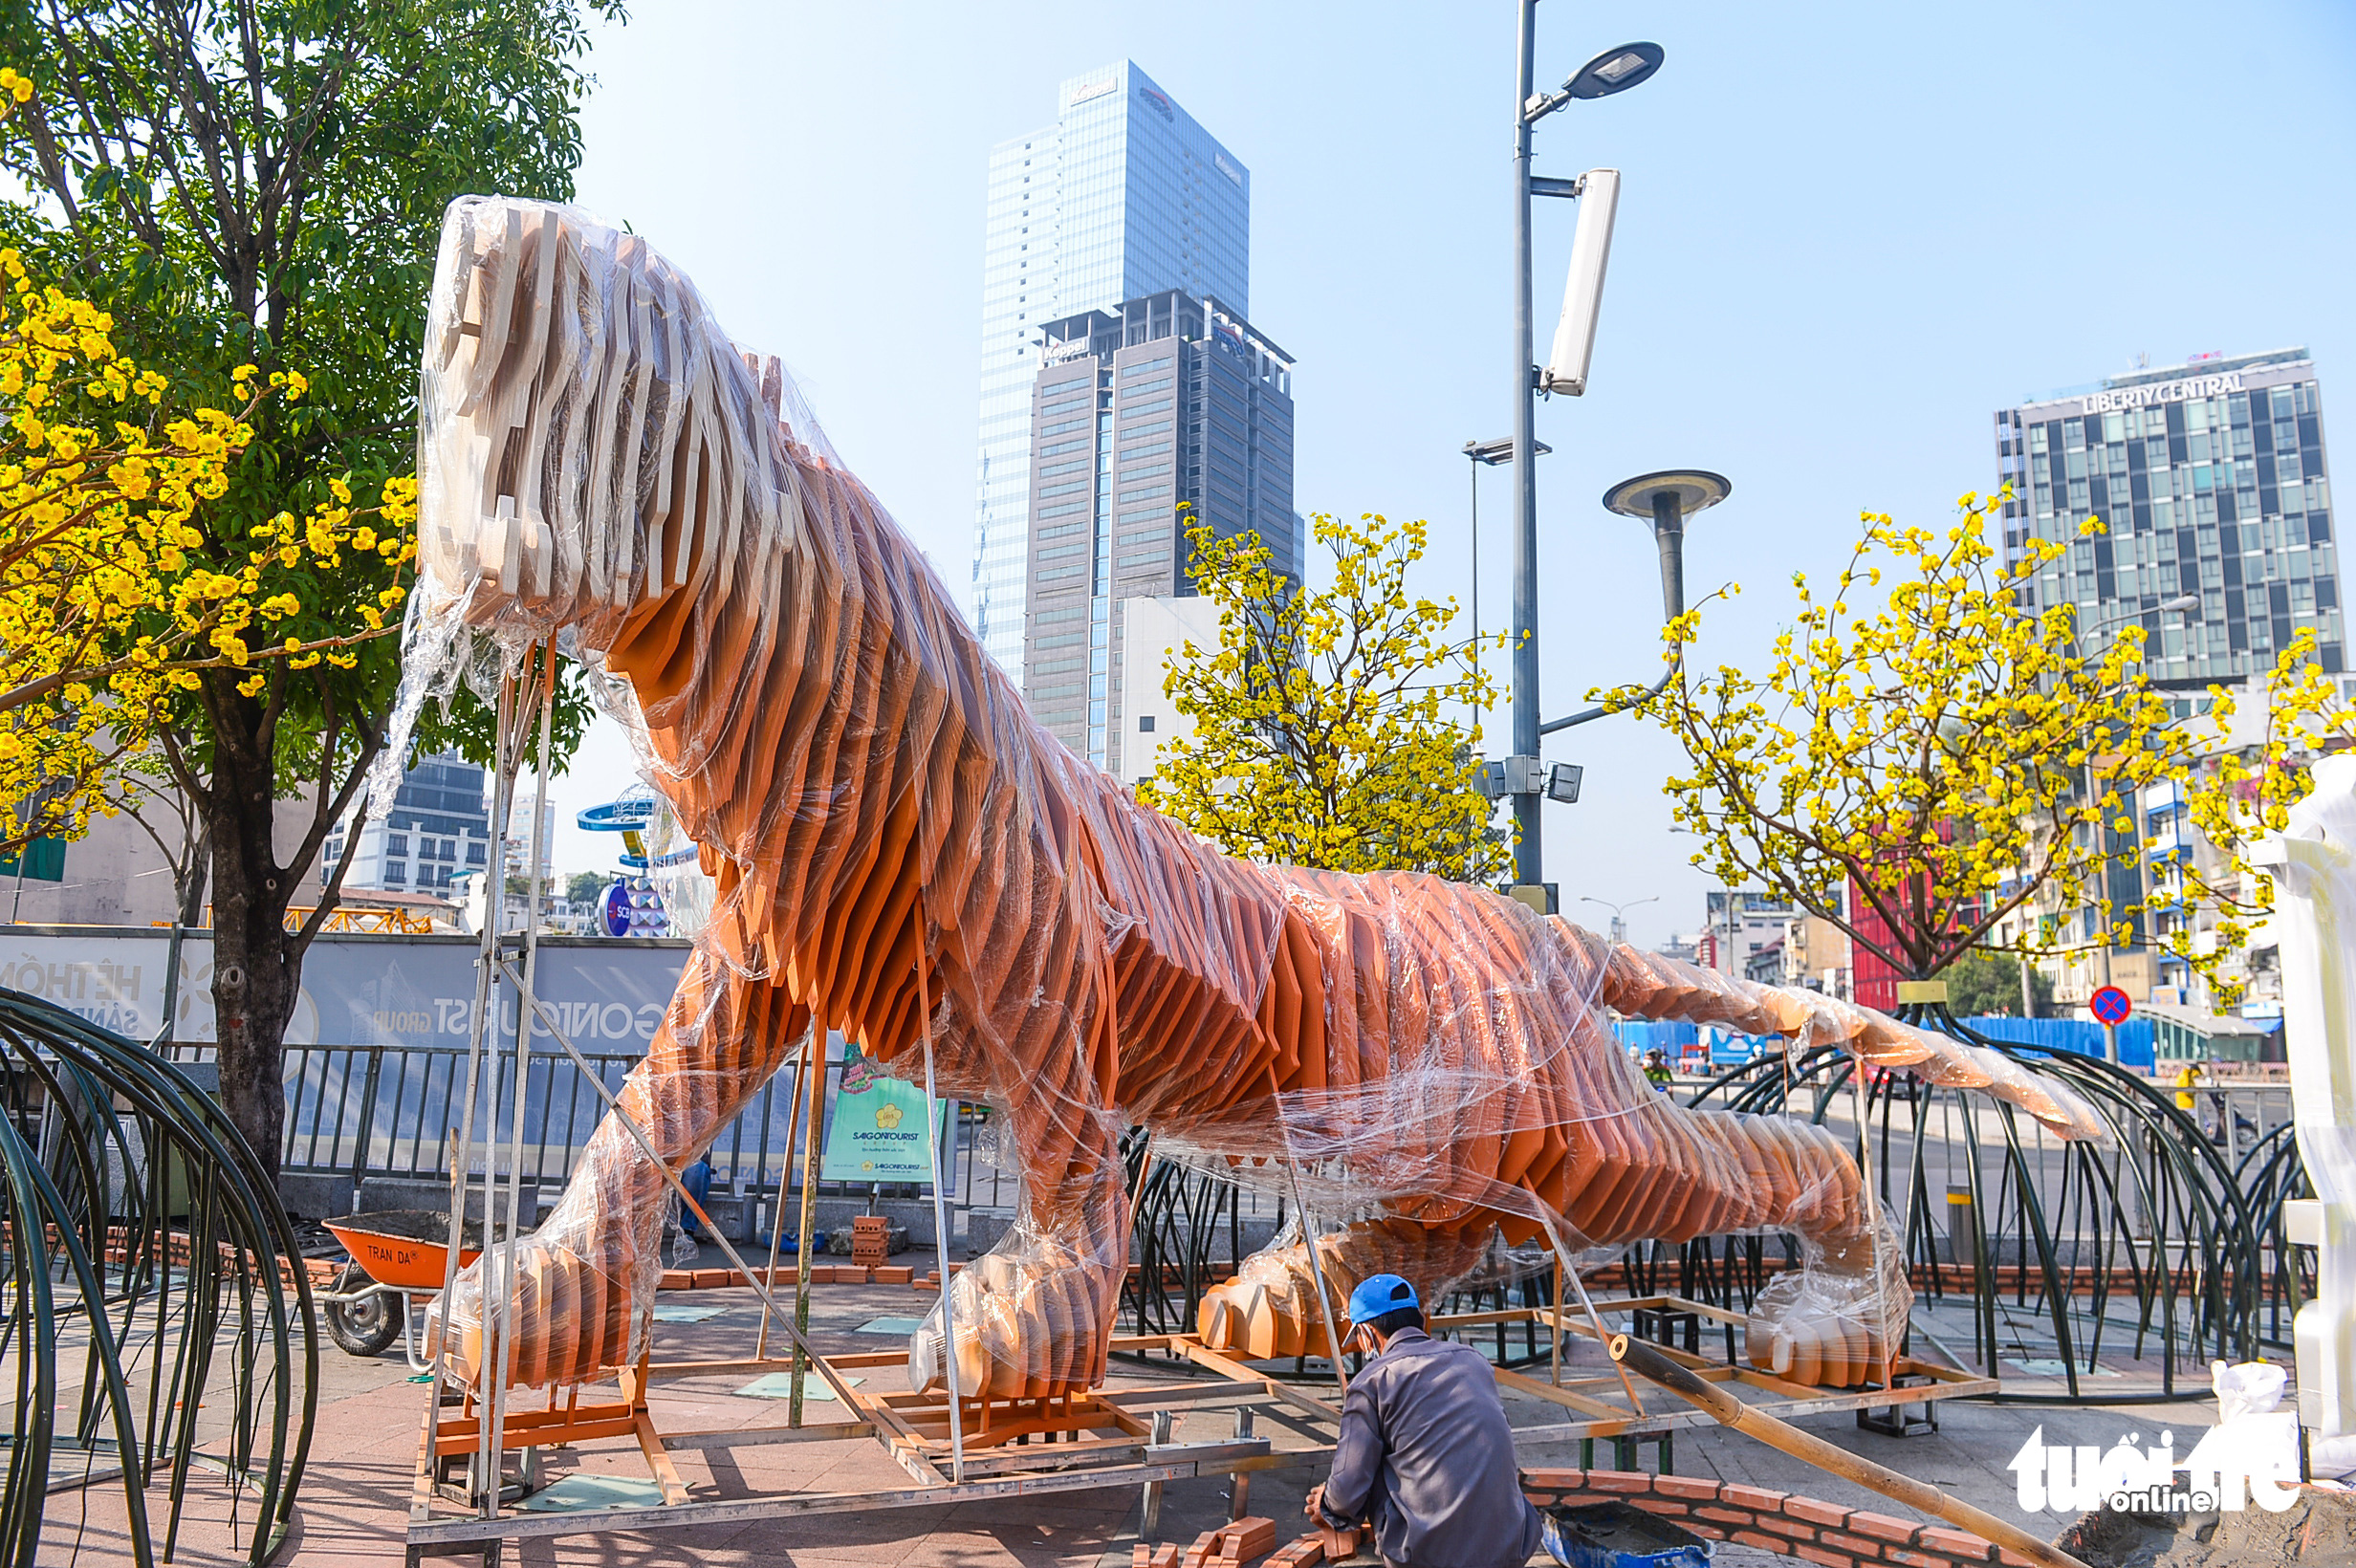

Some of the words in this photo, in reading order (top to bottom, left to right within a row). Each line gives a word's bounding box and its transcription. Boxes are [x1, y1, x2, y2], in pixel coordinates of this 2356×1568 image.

[1044, 338, 1086, 360] Keppel
[617, 905, 630, 919] SCB
[852, 1132, 919, 1141] SAIGONTOURIST
[367, 1245, 393, 1262] TRAN
